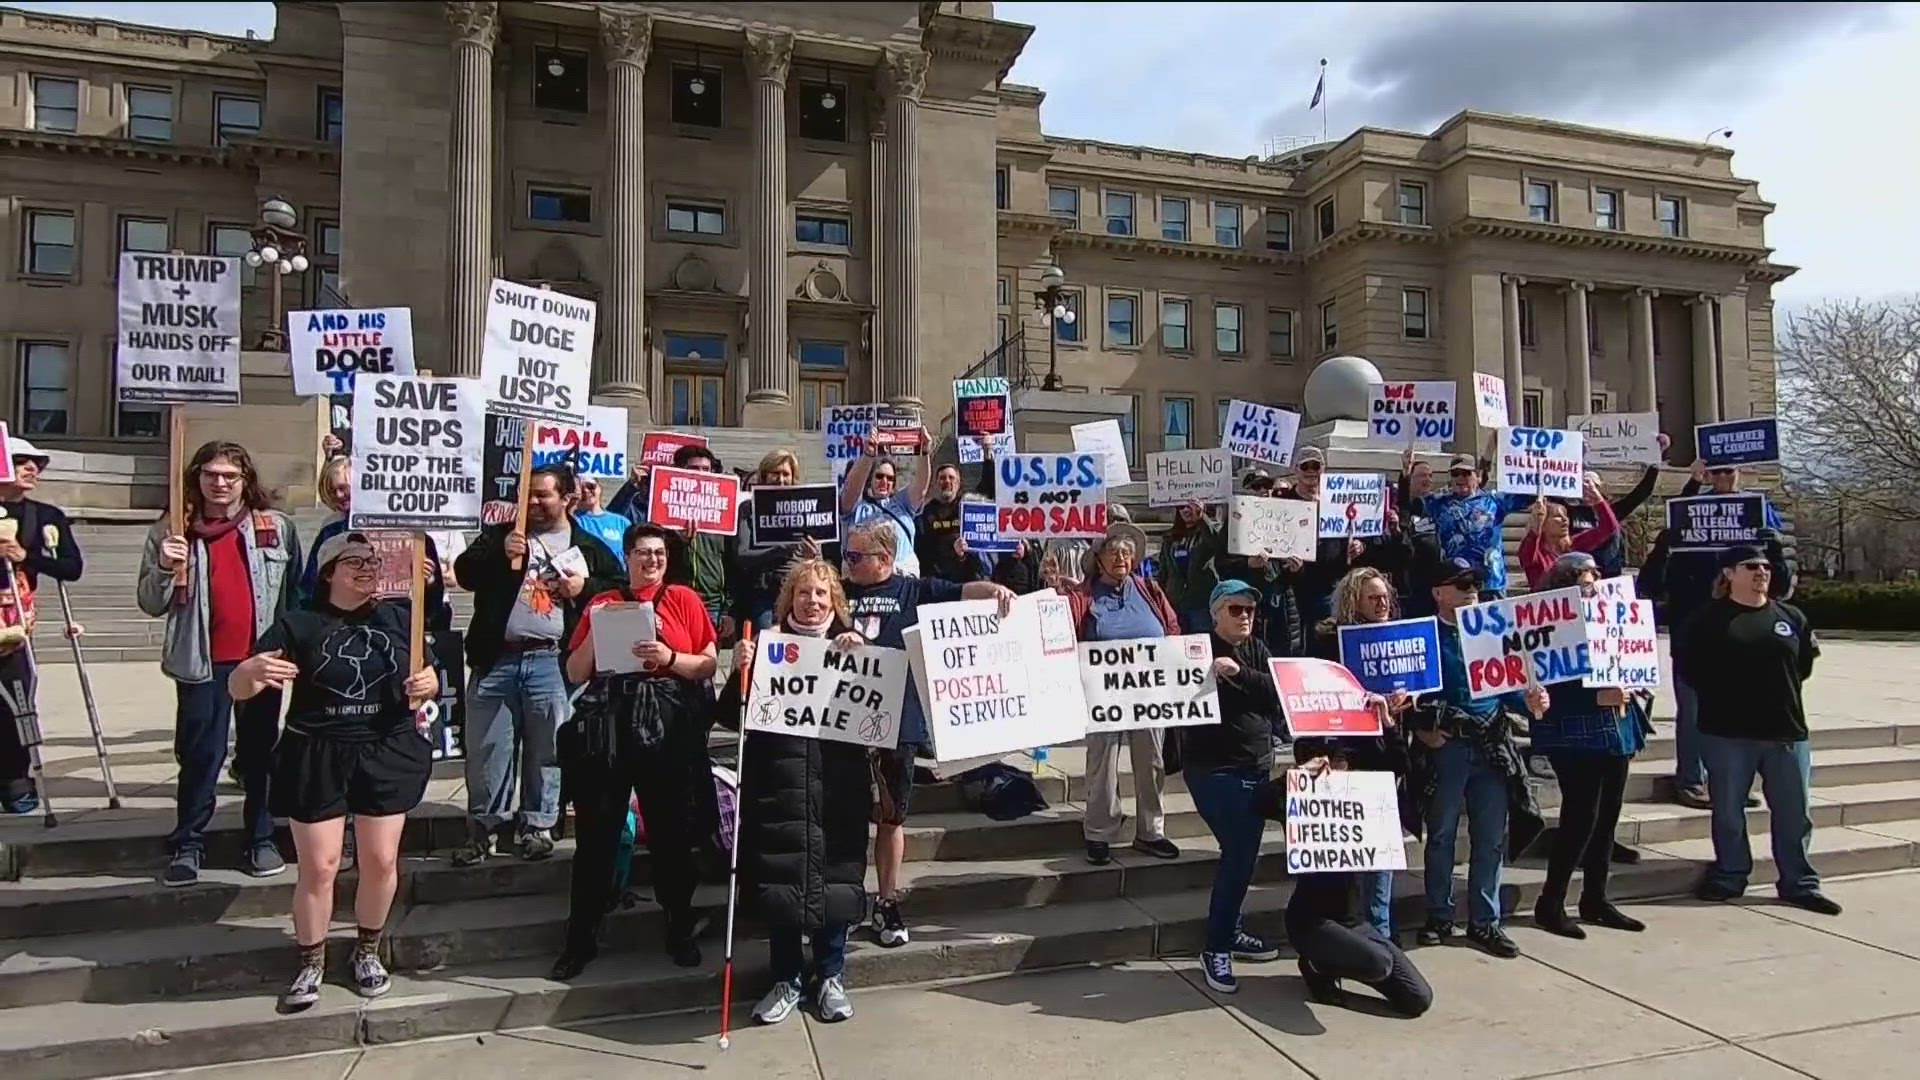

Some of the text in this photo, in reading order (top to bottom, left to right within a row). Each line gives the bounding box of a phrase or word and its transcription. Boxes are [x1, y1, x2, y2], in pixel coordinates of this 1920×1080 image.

[133, 256, 226, 283] TRUMP
[172, 284, 191, 300] +
[142, 303, 218, 328] MUSK
[495, 288, 591, 322] SHUT DOWN
[307, 313, 386, 332] AND HIS
[129, 331, 233, 352] HANDS OFF
[323, 332, 382, 347] LITTLE
[510, 319, 575, 352] DOGE
[316, 347, 394, 373] DOGE
[518, 357, 559, 381] NOT
[132, 363, 225, 384] OUR MAIL!
[375, 379, 457, 412] SAVE
[499, 375, 572, 410] USPS
[956, 379, 1009, 397] HANDS
[1384, 383, 1415, 399] WE
[832, 407, 874, 422] DOGE
[1242, 404, 1277, 428] U.S.
[1373, 400, 1449, 414] DELIVER
[376, 417, 463, 448] USPS
[538, 426, 608, 448] MAIL
[827, 422, 871, 435] RETUR
[1231, 421, 1280, 446] MAIL
[1372, 417, 1453, 438] TO YOU
[1577, 419, 1638, 438] HELL NO
[1709, 429, 1765, 444] NOVEMBER
[1510, 428, 1564, 450] STOP
[1711, 441, 1765, 456] IS COMING
[826, 444, 863, 458] SEN
[1524, 449, 1547, 458] THE
[366, 454, 463, 474] STOP THE
[578, 452, 624, 476] SALE
[1002, 454, 1103, 487] U.S.P.S.
[1157, 454, 1222, 477] HELL NO
[1504, 455, 1578, 473] BILLIONAIRE
[361, 473, 476, 494] BILLIONAIRE
[670, 476, 720, 496] STOP THE
[1326, 476, 1382, 490] 169 MILLION
[388, 493, 450, 513] COUP
[662, 488, 729, 511] BILLIONAIRE
[776, 499, 818, 514] NOBODY
[1014, 490, 1082, 504] IS NOT
[1331, 493, 1378, 506] ADDRESSES
[668, 504, 721, 523] TAKEOVER
[759, 512, 834, 528] ELECTED MUSK
[999, 505, 1107, 534] FOR SALE
[1346, 502, 1356, 519] 6
[1688, 503, 1744, 517] STOP THE
[1320, 517, 1344, 532] DAYS
[1354, 519, 1382, 533] WEEK
[1692, 516, 1741, 529] ILLEGAL
[1462, 597, 1577, 636] U.S. MAIL
[1582, 600, 1644, 625] U.S.P.S.
[931, 613, 1000, 640] HANDS
[1606, 626, 1624, 638] FOR
[1360, 637, 1426, 660] NOVEMBER
[1502, 625, 1555, 655] NOT
[1618, 639, 1653, 654] PEOPLE
[767, 642, 883, 678] US MAIL
[943, 644, 978, 669] OFF
[1089, 644, 1157, 667] DON'T
[1363, 655, 1426, 677] IS COMING
[1610, 655, 1621, 670] BY
[1104, 667, 1205, 690] MAKE US
[1469, 643, 1593, 692] FOR SALE
[1619, 667, 1657, 684] PEOPLE
[770, 675, 884, 711] NOT FOR
[934, 673, 1009, 702] POSTAL
[784, 706, 850, 731] SALE
[949, 695, 1028, 727] SERVICE
[1092, 700, 1215, 723] GO POSTAL
[1288, 772, 1317, 794] NOT
[1288, 797, 1365, 820] ANOTHER
[1289, 823, 1363, 845] LIFELESS
[1288, 847, 1376, 870] COMPANY
